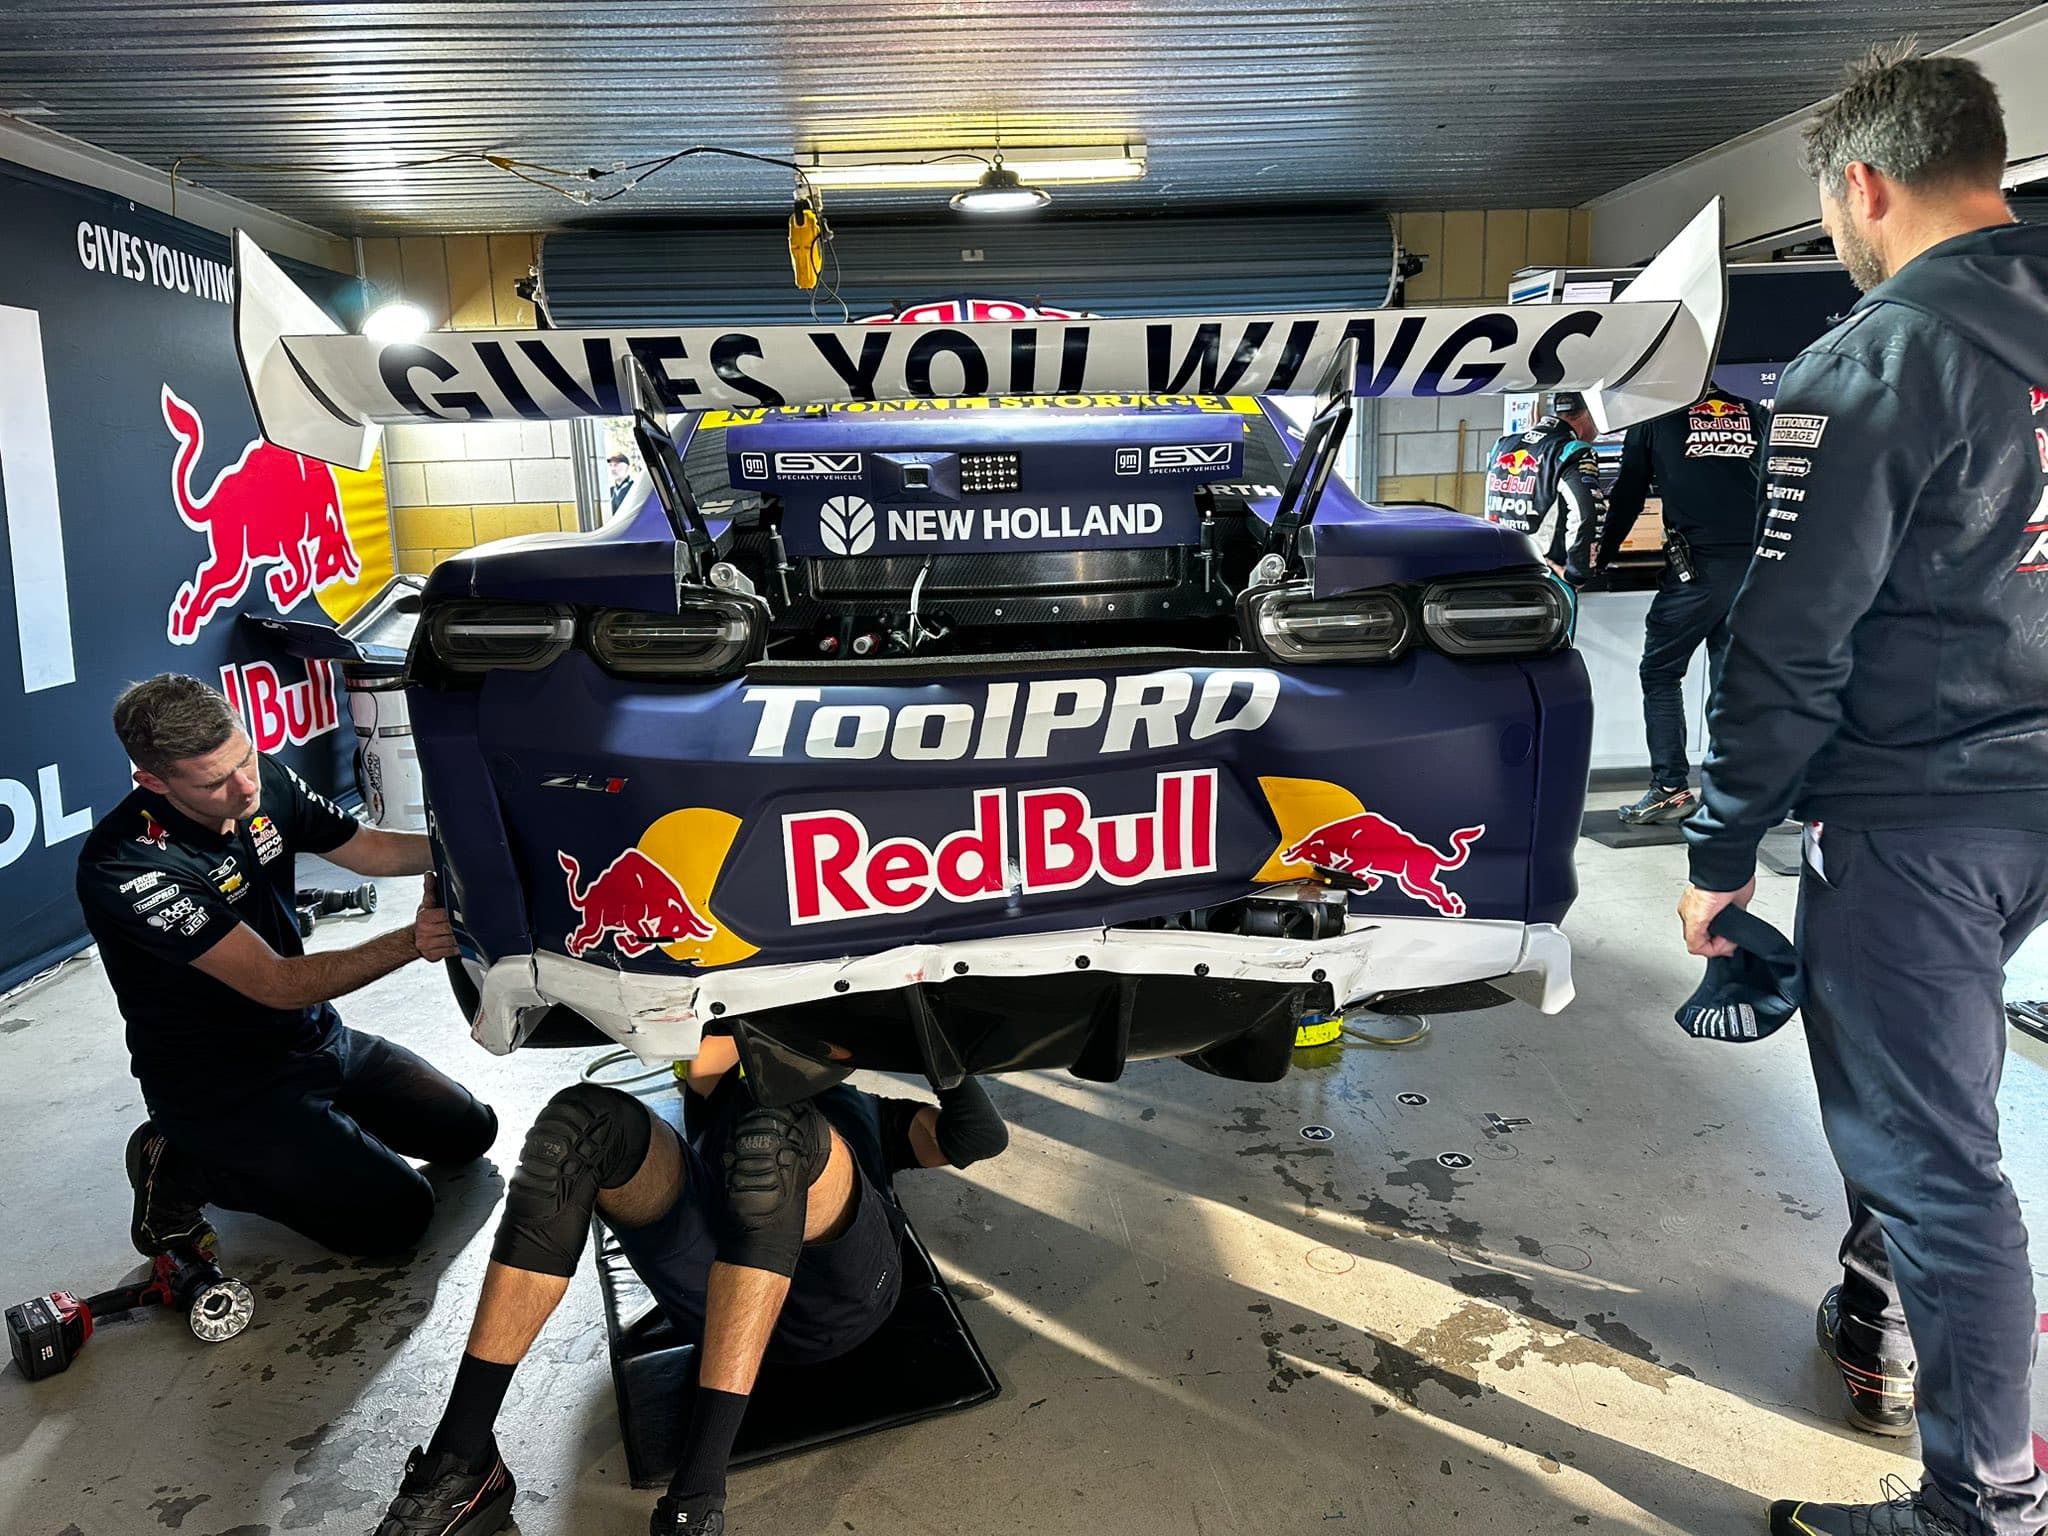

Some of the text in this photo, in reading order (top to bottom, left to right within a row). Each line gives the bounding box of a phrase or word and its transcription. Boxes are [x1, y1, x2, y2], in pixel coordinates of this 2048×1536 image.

[77, 221, 146, 282] GIVES
[144, 240, 190, 294] YOU
[378, 310, 1604, 420] GIVES YOU WINGS
[1721, 417, 1750, 431] Bull
[1685, 432, 1758, 445] AMPOL
[1685, 443, 1755, 457] RACING
[776, 453, 861, 473] SV
[1150, 443, 1231, 467] SV
[1149, 464, 1231, 475] SPECIALTY VEHICLES
[1509, 475, 1536, 494] Bull
[888, 503, 1163, 541] NEW HOLLAND
[241, 660, 340, 754] Bull
[742, 671, 1281, 761] ToolPRO
[781, 767, 1218, 926] Red Bull
[135, 888, 176, 911] ToolPRO
